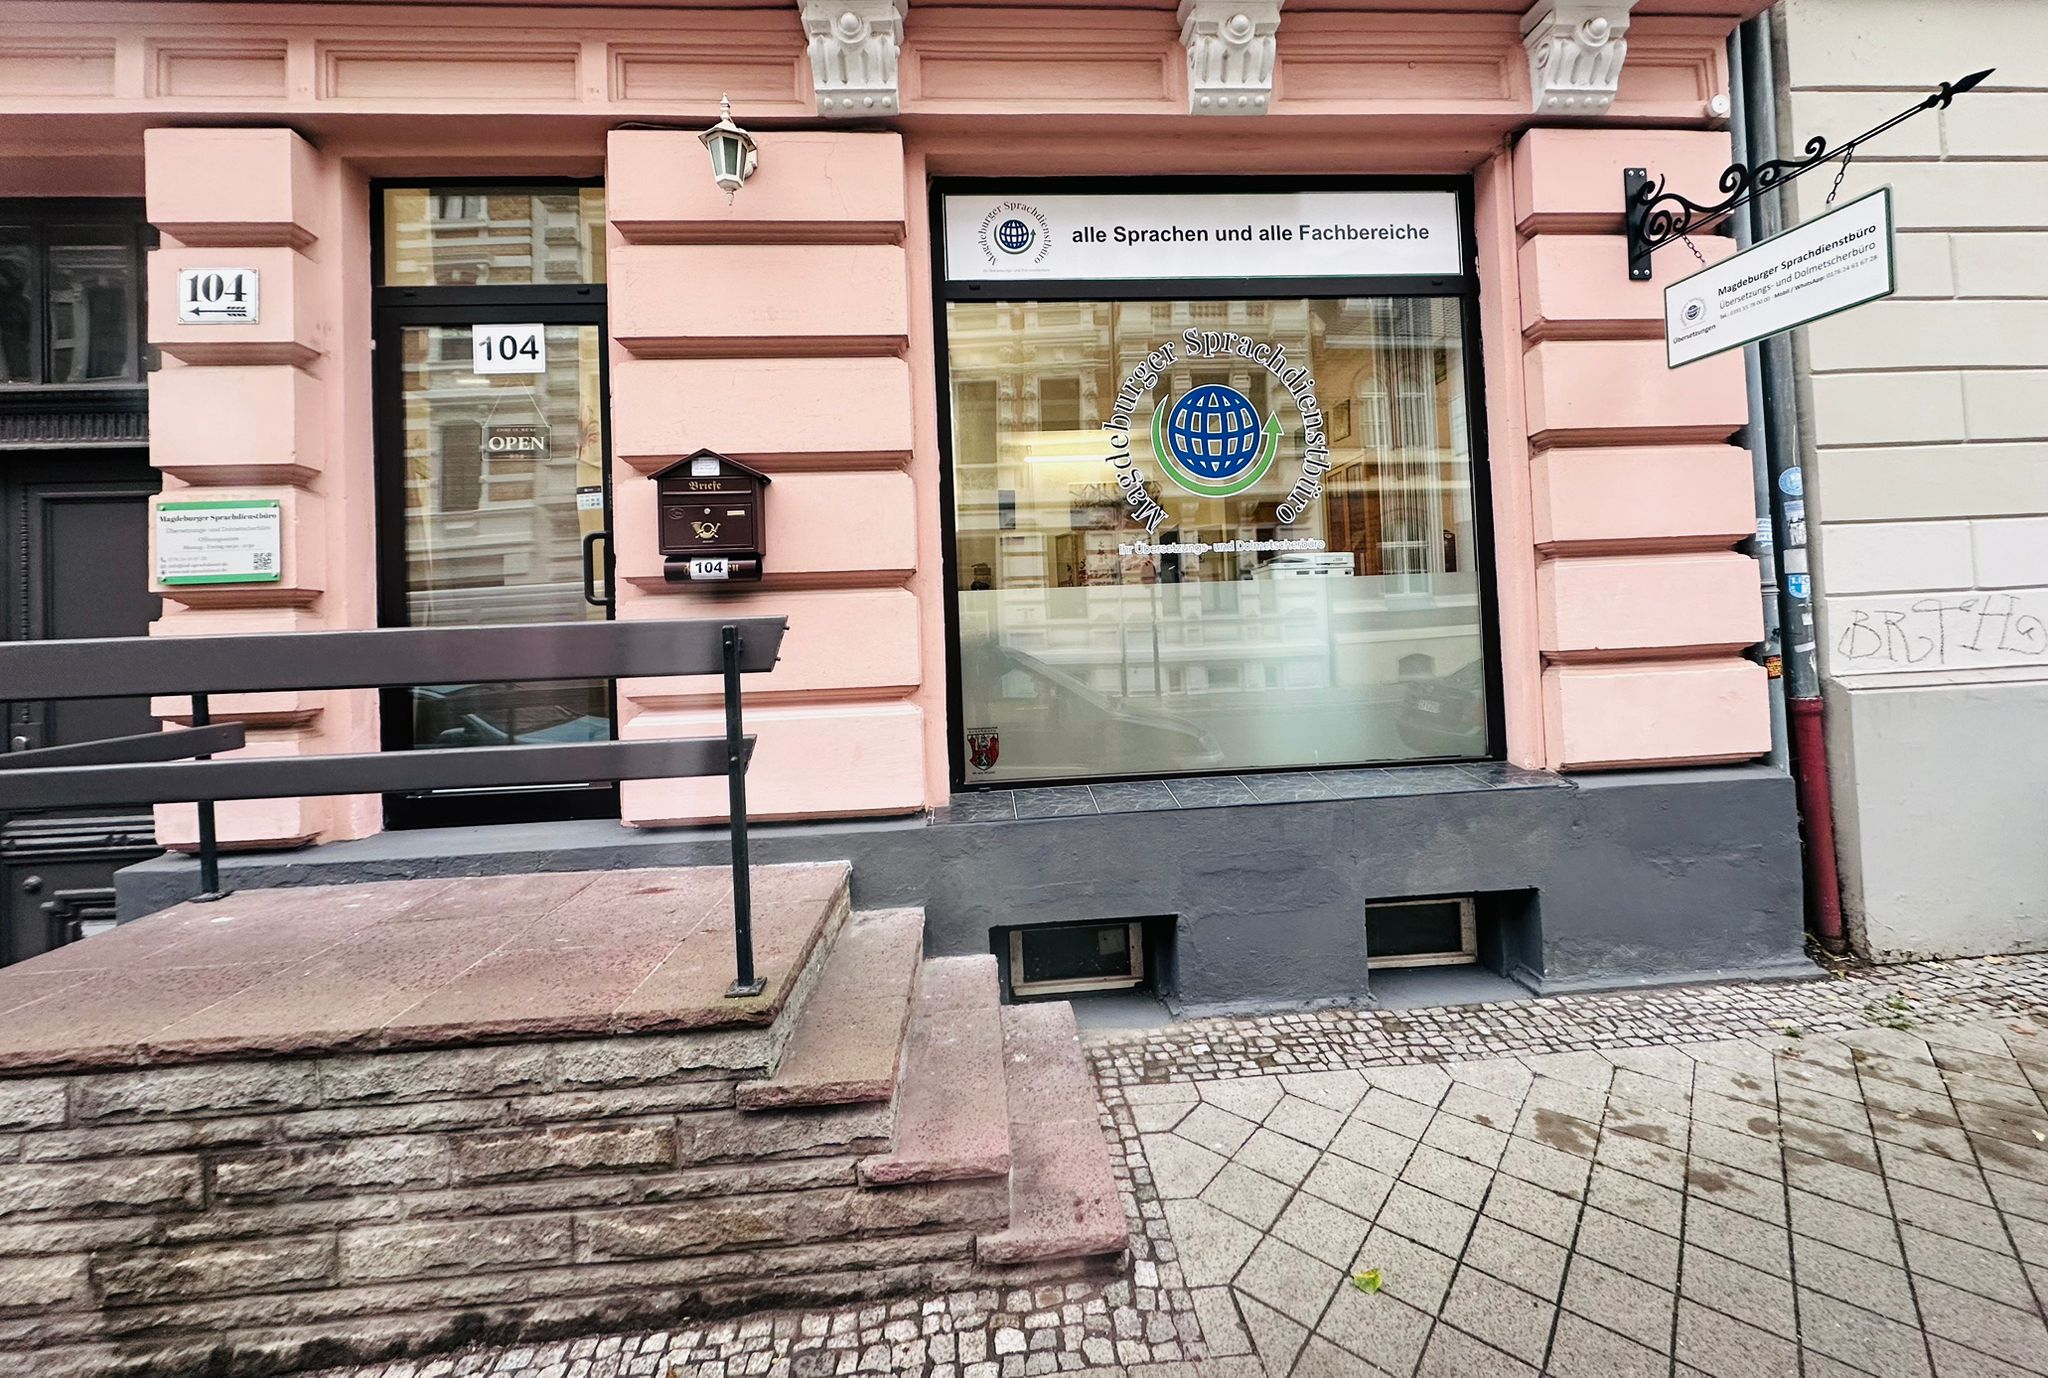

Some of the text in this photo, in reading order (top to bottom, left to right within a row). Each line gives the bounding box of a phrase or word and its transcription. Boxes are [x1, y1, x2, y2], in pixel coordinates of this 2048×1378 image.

[1072, 224, 1430, 246] alle Sprachen und alle Fachbereiche
[1717, 225, 1876, 296] Magdeburger Sprachdienstbüro
[1719, 242, 1876, 310] Übersetzungs- und Dolmetscherbüro
[186, 273, 247, 303] 104
[1673, 324, 1716, 344] Übersetzungen
[478, 334, 540, 361] 104
[1102, 326, 1332, 534] Magdeburger Sprachdienstbüro
[488, 436, 545, 451] OPEN
[688, 480, 722, 491] Briefe
[1212, 540, 1235, 553] und
[694, 561, 724, 574] 104
